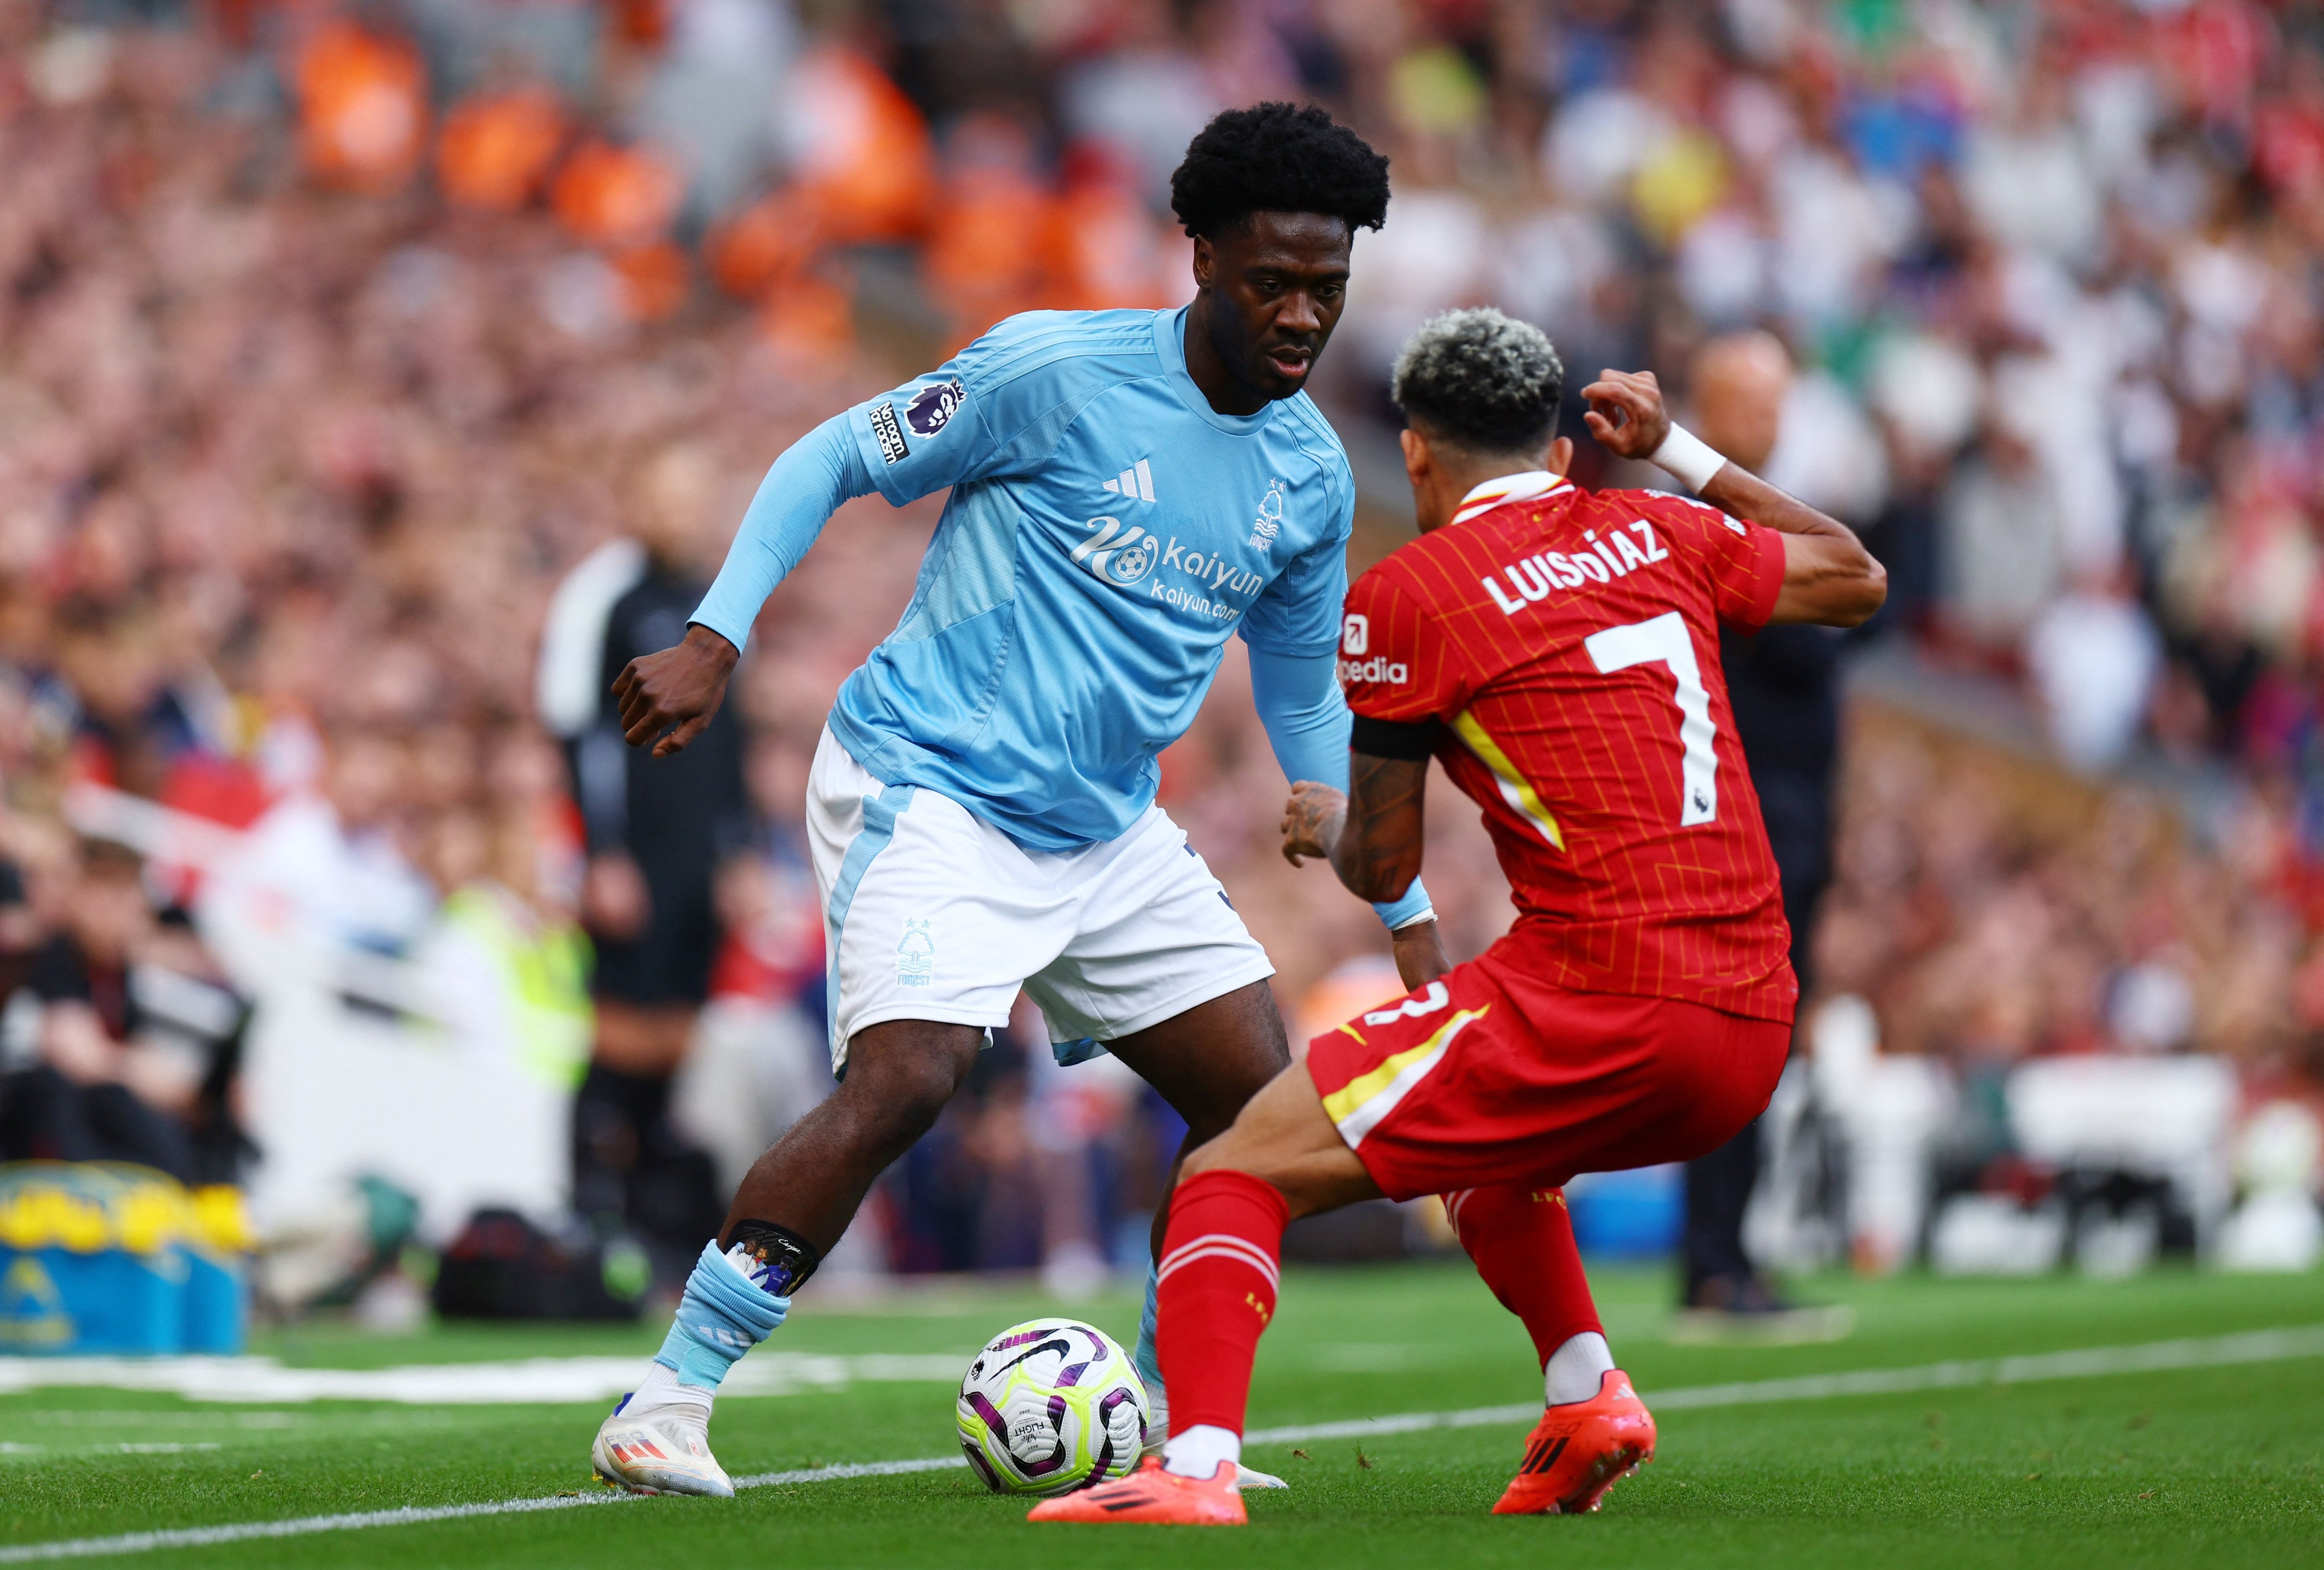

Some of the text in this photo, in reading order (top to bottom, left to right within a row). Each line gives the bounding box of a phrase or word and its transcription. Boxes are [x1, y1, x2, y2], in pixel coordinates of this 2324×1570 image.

[869, 407, 897, 465] for racism
[879, 401, 905, 455] No room
[1162, 537, 1263, 596] Kaiyun
[1150, 578, 1240, 622] Kaiyun.com
[1583, 610, 1718, 828] 7
[1015, 1422, 1044, 1437] FLIGHT
[1022, 1431, 1041, 1444] Nike
